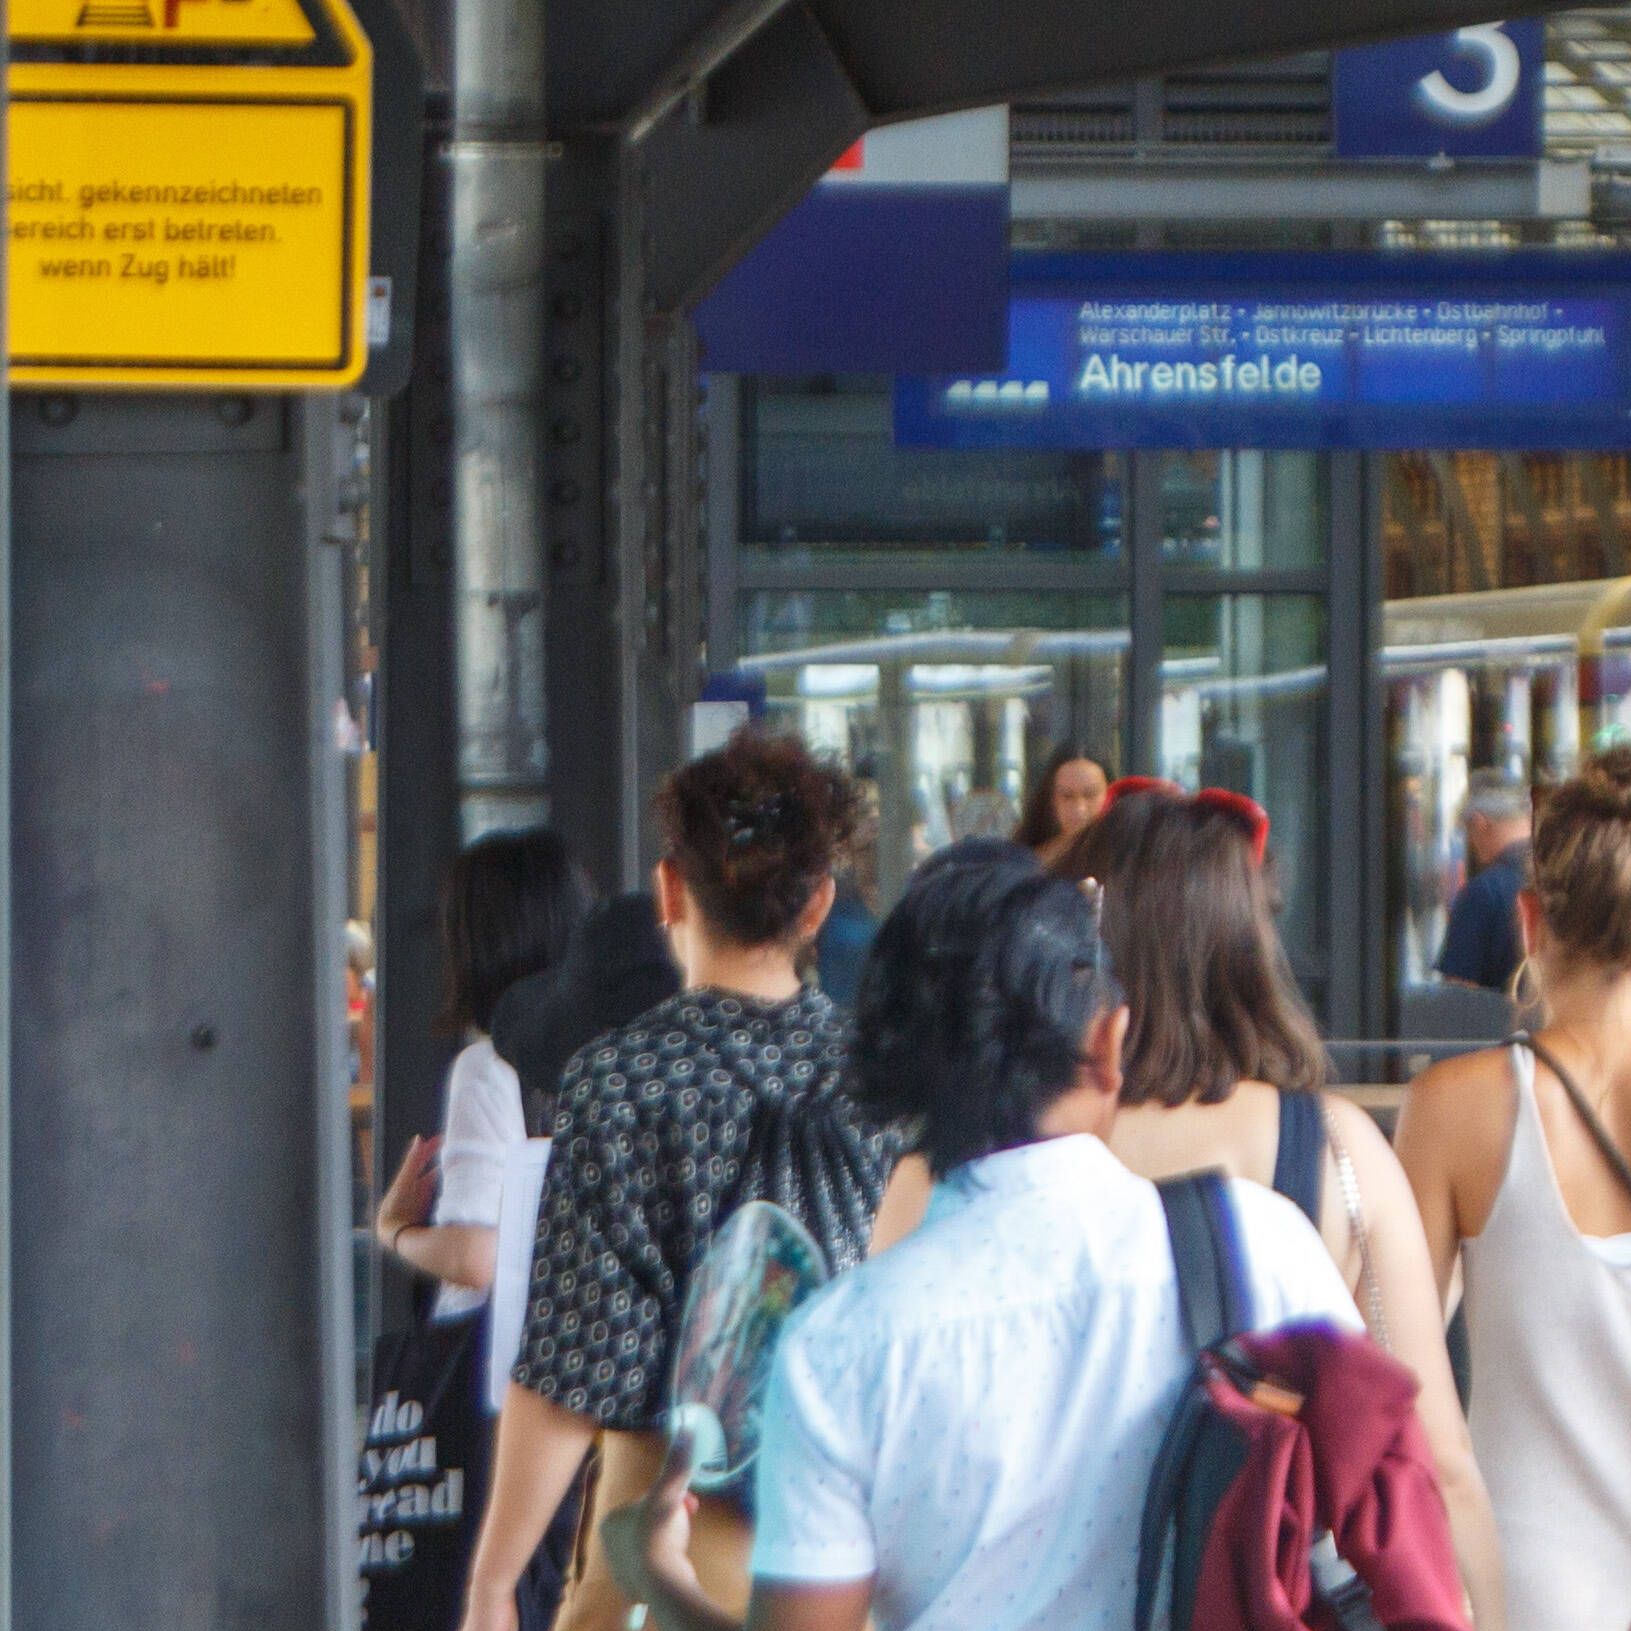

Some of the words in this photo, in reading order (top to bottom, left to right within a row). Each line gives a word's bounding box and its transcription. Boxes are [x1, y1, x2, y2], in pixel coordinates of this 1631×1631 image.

[1419, 20, 1521, 112] 3
[79, 181, 323, 209] gekennzeichneten
[9, 217, 95, 241] ereich
[103, 218, 156, 241] erst
[39, 257, 112, 278] wenn
[119, 252, 170, 285] Zug
[177, 254, 237, 279] hält!
[1079, 302, 1232, 323] Alexanderplatz
[1079, 325, 1193, 344] Warschauer
[1199, 325, 1237, 345] Str.
[1254, 325, 1344, 344] Ostkreuz
[1364, 324, 1479, 350] Lichtenberg
[1079, 352, 1323, 391] Ahrensfelde
